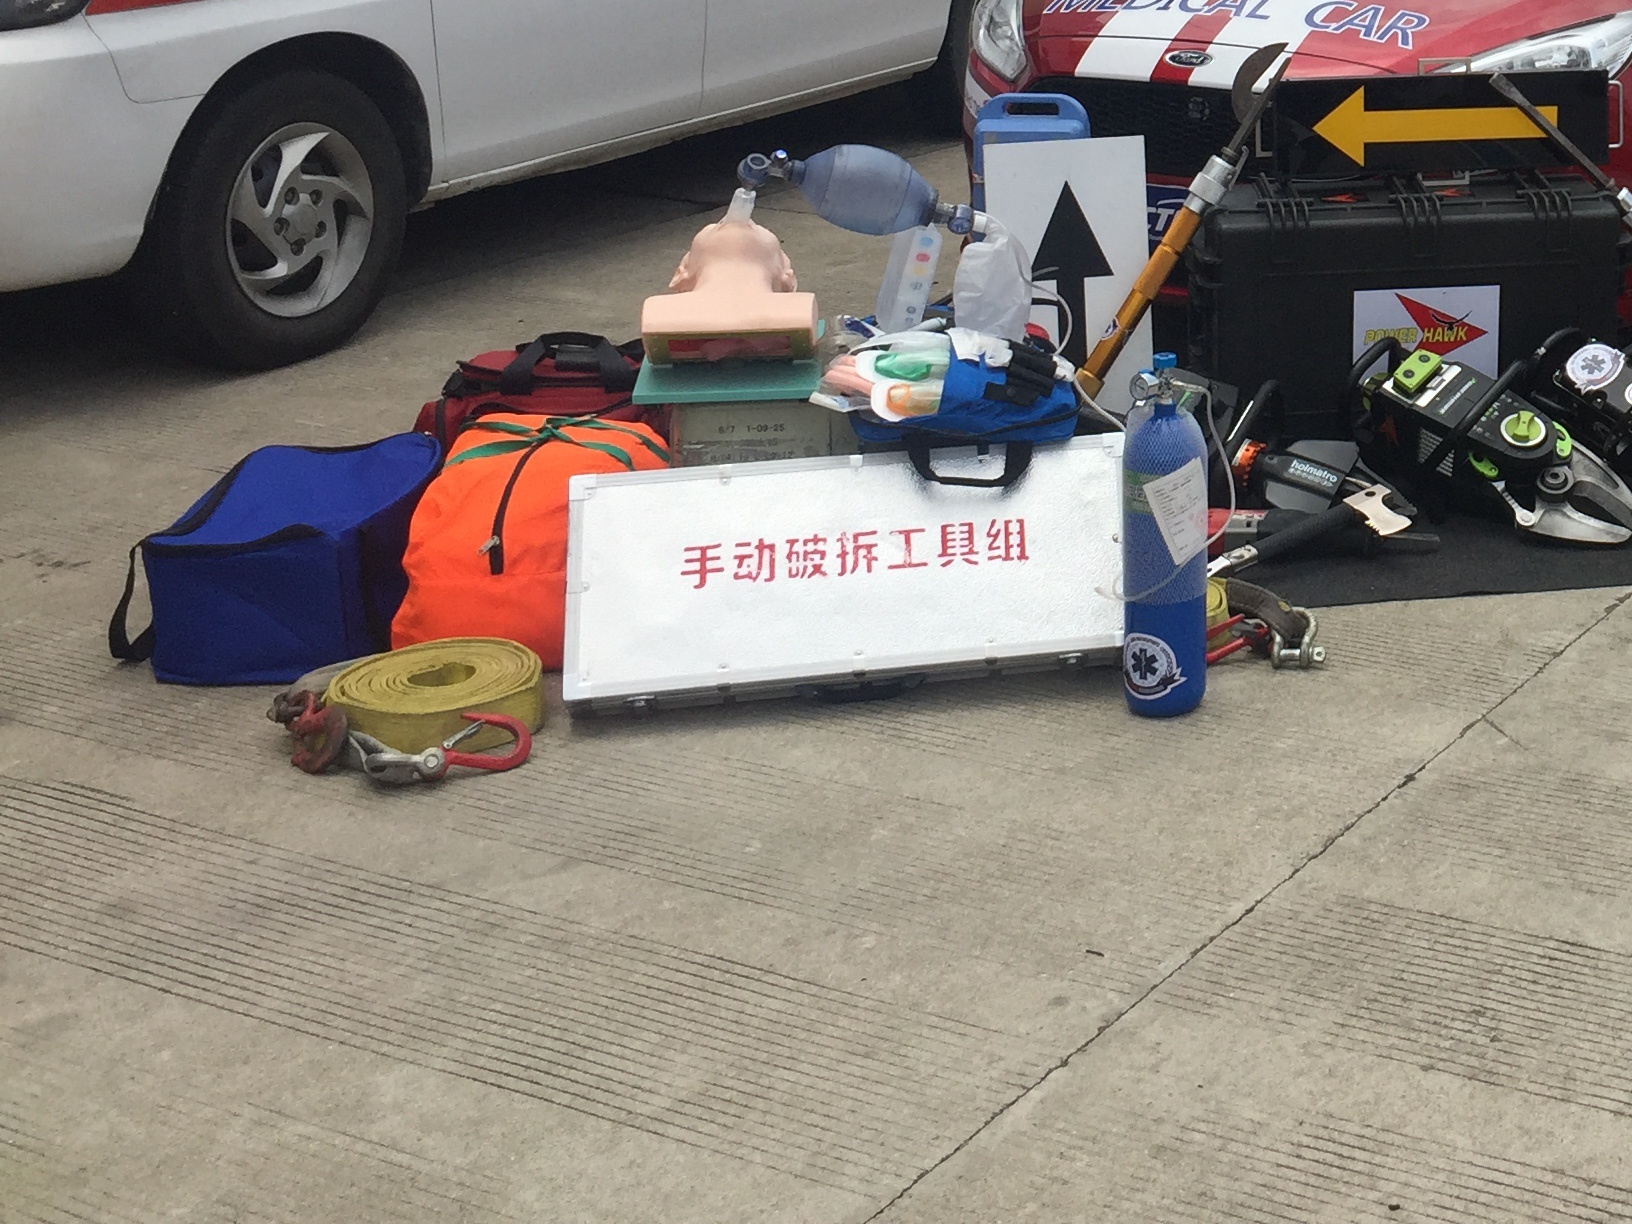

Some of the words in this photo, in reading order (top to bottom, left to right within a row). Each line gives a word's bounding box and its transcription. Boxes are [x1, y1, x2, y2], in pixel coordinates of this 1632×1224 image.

[1303, 0, 1430, 50] CAR
[1422, 326, 1469, 343] HAWK
[1290, 459, 1338, 483] holmatro
[680, 517, 1031, 590] 手动破拆工具组
